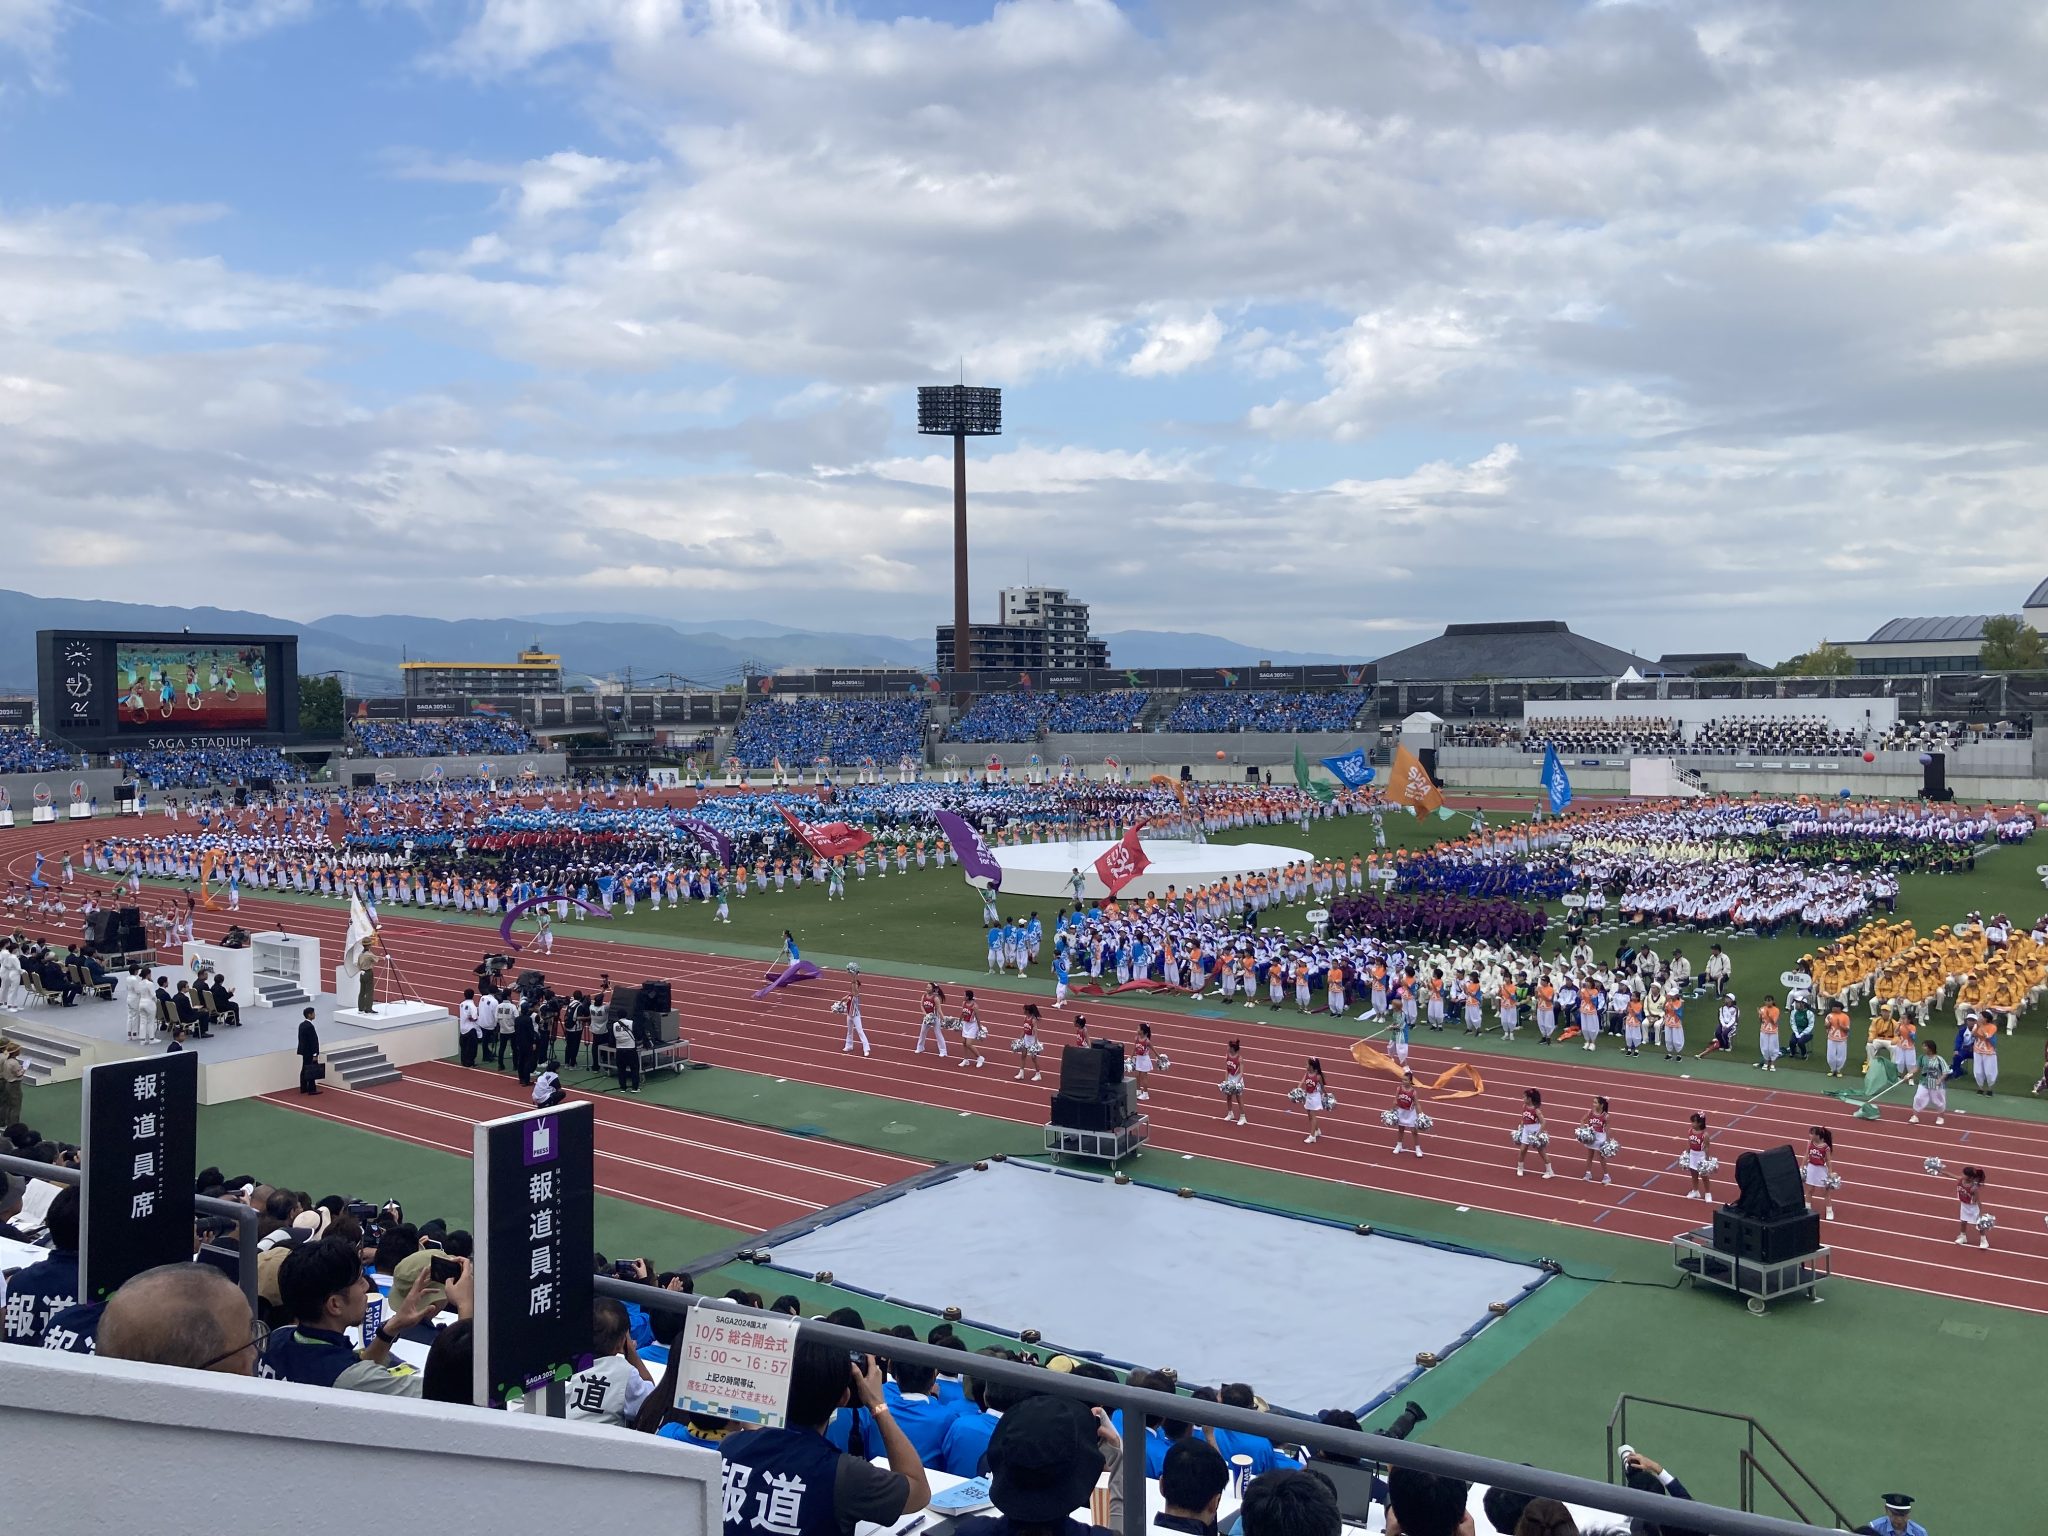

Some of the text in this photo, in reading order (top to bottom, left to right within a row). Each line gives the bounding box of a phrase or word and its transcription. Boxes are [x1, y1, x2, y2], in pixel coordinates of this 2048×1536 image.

[148, 736, 251, 749] SAGA STADIUM
[130, 1073, 157, 1219] 報道員席
[533, 1146, 549, 1156] PRESS
[529, 1170, 553, 1316] 報道員席
[365, 1307, 373, 1341] SWEAT
[715, 1315, 768, 1330] SAGA2024国スポ
[695, 1324, 788, 1353] 10/5 総合開会式
[526, 1368, 556, 1386] SAGA 2024
[705, 1372, 757, 1389] 上記の時間帯は、
[570, 1374, 611, 1414] 道
[687, 1379, 777, 1405] 席を立つことができません
